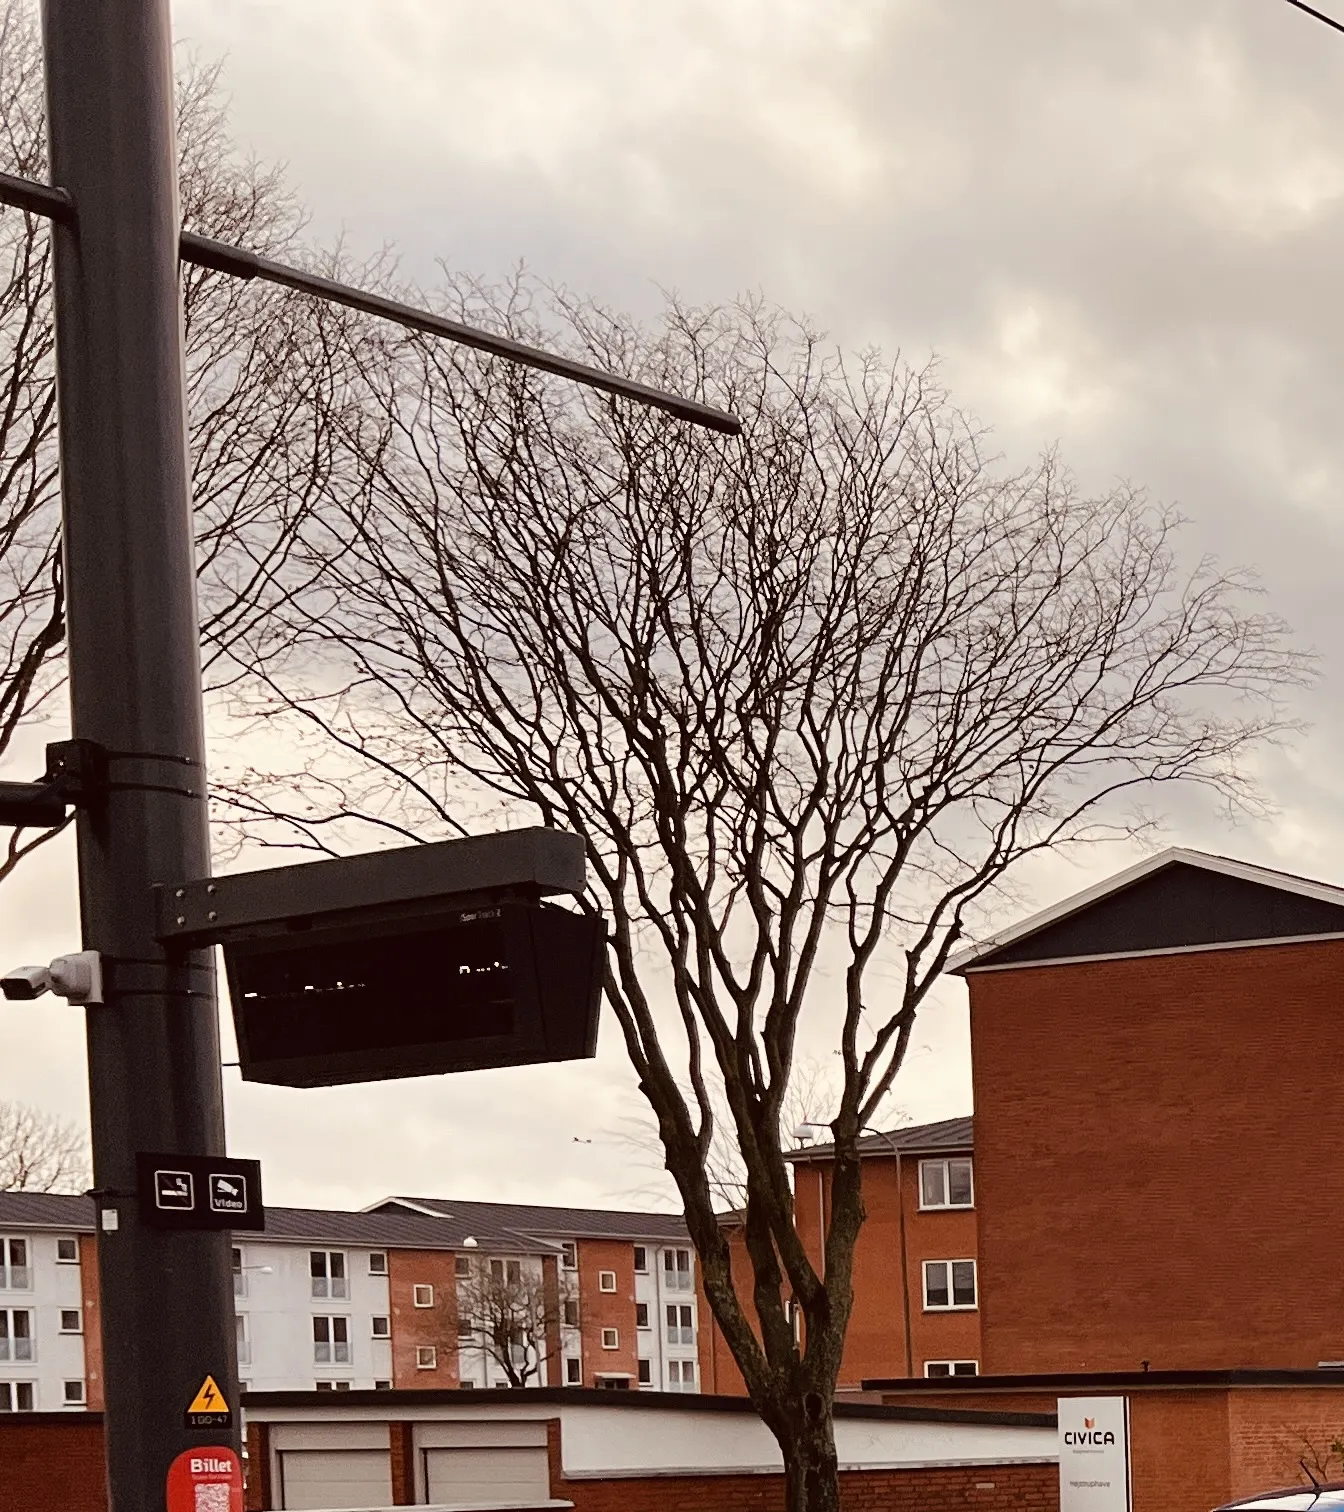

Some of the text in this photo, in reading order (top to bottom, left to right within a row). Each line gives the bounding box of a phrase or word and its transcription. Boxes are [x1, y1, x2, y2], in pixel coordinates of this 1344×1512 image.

[213, 1198, 243, 1209] Video
[1064, 1431, 1115, 1446] CIVICA
[190, 1458, 232, 1473] Billet
